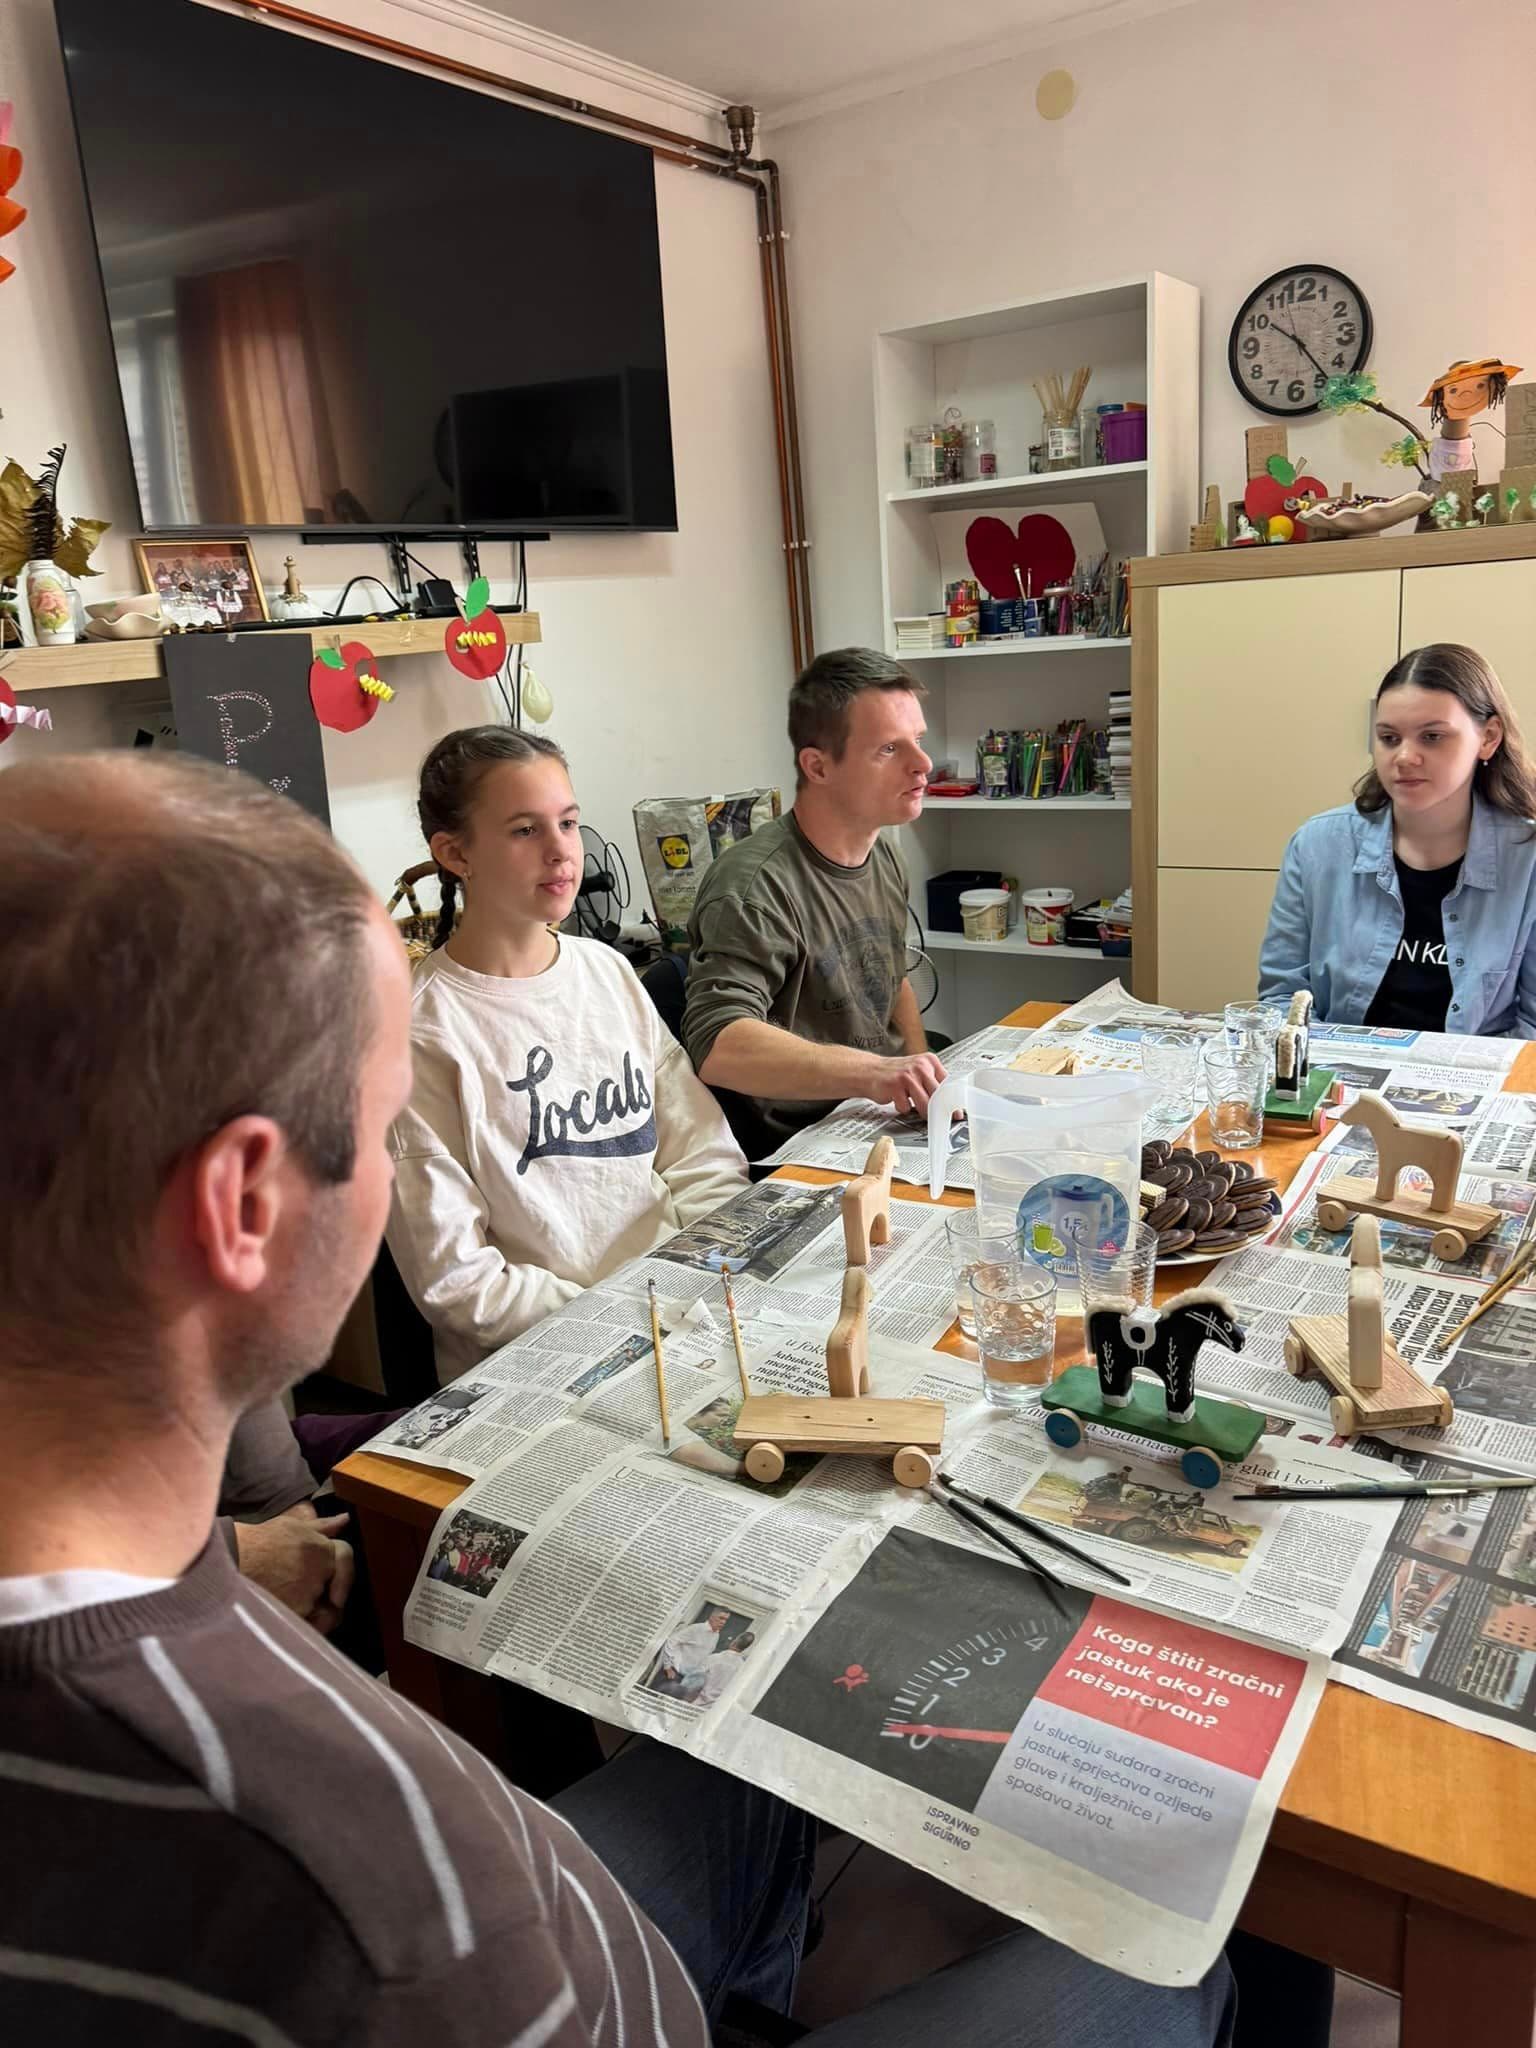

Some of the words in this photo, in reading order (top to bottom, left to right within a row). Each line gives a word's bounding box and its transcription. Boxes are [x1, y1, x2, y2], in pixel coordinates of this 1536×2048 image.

[1265, 292, 1285, 310] 11
[1283, 277, 1316, 304] 12
[1318, 285, 1328, 302] 1
[1333, 301, 1348, 318] 2
[1248, 314, 1269, 331] 10
[1336, 322, 1356, 346] 3
[1242, 337, 1260, 359] 9
[1331, 352, 1345, 368] 4
[1251, 364, 1263, 380] 8
[1314, 373, 1327, 389] 5
[1267, 379, 1279, 396] 7
[1287, 379, 1305, 402] 6
[505, 1045, 652, 1176] Locals
[1024, 1636, 1049, 1651] 4
[982, 1647, 1007, 1666] 3
[1091, 1624, 1154, 1657] Koga
[1156, 1644, 1204, 1674] štiti
[1206, 1662, 1286, 1699] zračni
[942, 1667, 971, 1688] 2
[1074, 1645, 1154, 1681] jastuk
[1156, 1675, 1201, 1698] ako
[1203, 1686, 1230, 1709] je
[920, 1694, 940, 1716] 1
[1065, 1665, 1219, 1729] neispravan?
[1047, 1723, 1102, 1755] slučaju
[1104, 1746, 1161, 1779] sudara
[1163, 1770, 1216, 1799] zračni
[1014, 1755, 1058, 1780] glave
[1060, 1772, 1067, 1785] i
[1067, 1775, 1153, 1821] kralježnice
[1154, 1812, 1162, 1825] i
[1021, 1735, 1073, 1765] jastuk
[1071, 1756, 1151, 1798] sprječava
[1153, 1789, 1214, 1823] ozljede
[1005, 1773, 1073, 1812] spašava
[927, 1806, 980, 1837] ISPRAVNO
[922, 1821, 971, 1851] SIGURNO
